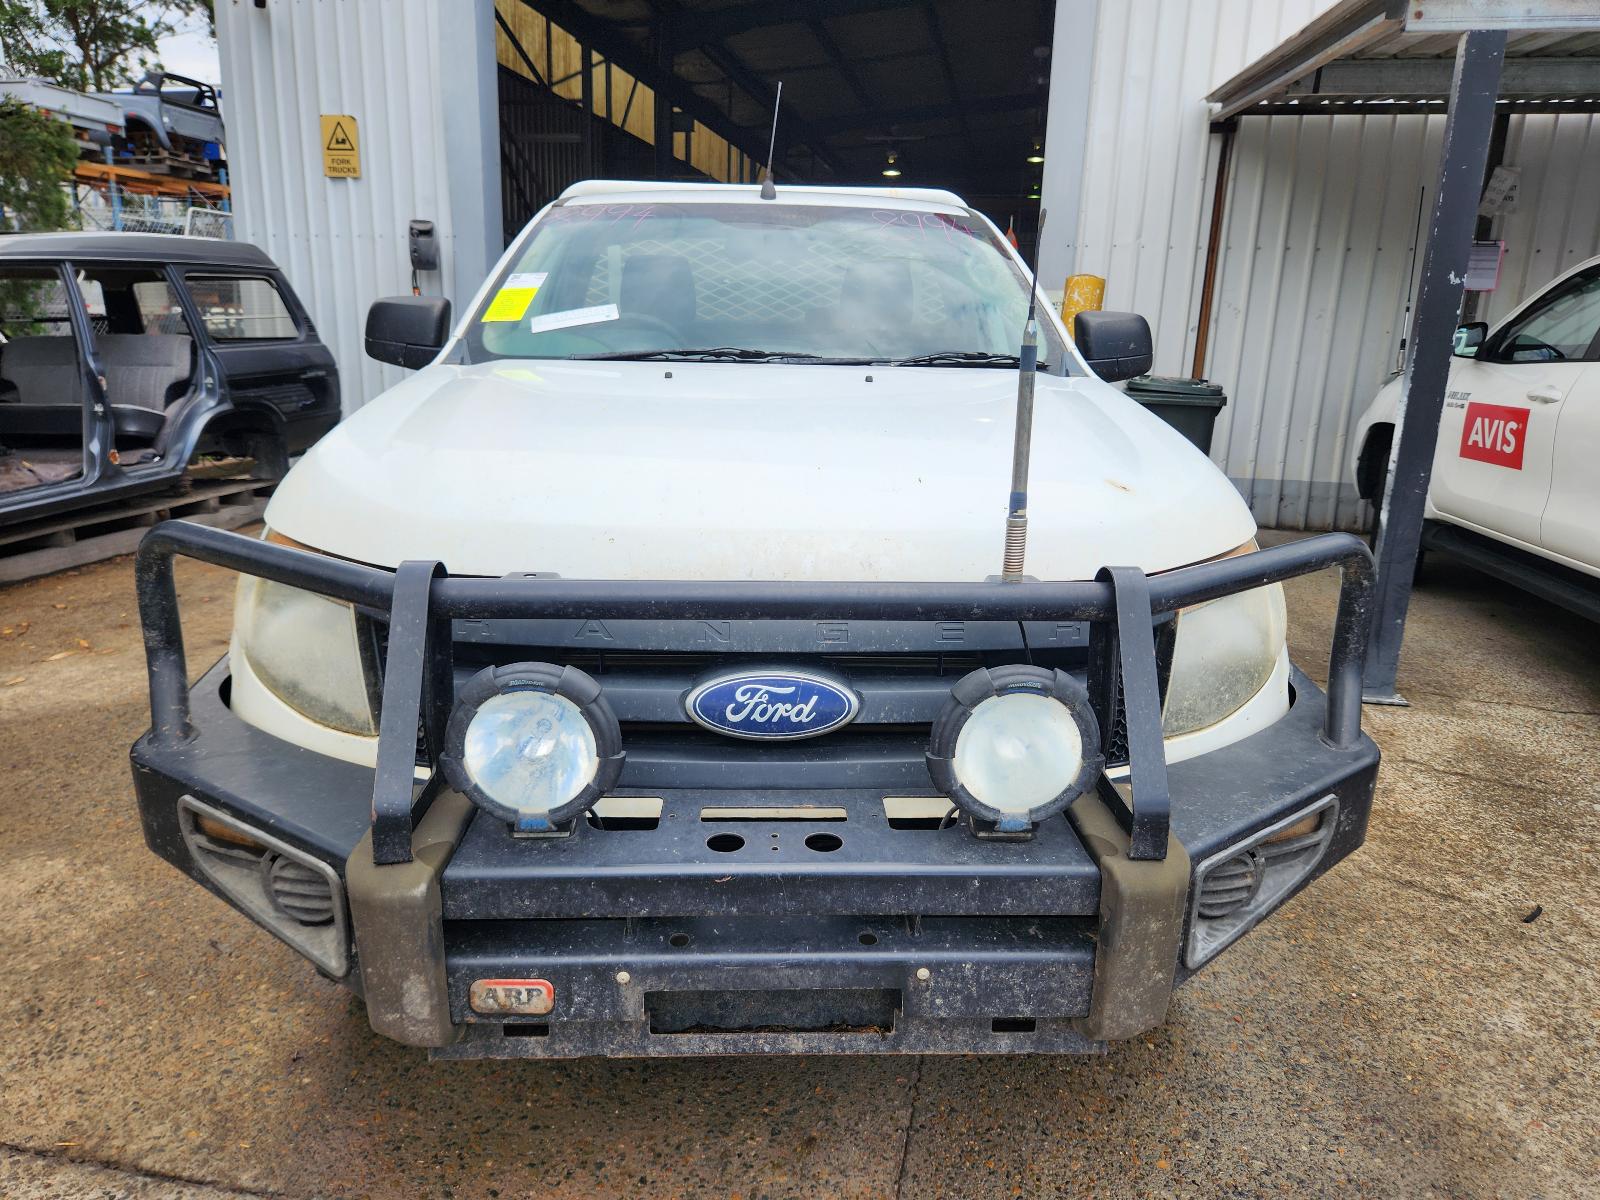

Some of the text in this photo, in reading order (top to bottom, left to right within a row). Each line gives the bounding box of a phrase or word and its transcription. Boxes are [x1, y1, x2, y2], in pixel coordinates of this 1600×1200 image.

[328, 166, 358, 175] TRUCKS
[331, 158, 351, 166] FORK
[1467, 416, 1519, 454] AVIS
[725, 684, 819, 723] Ford
